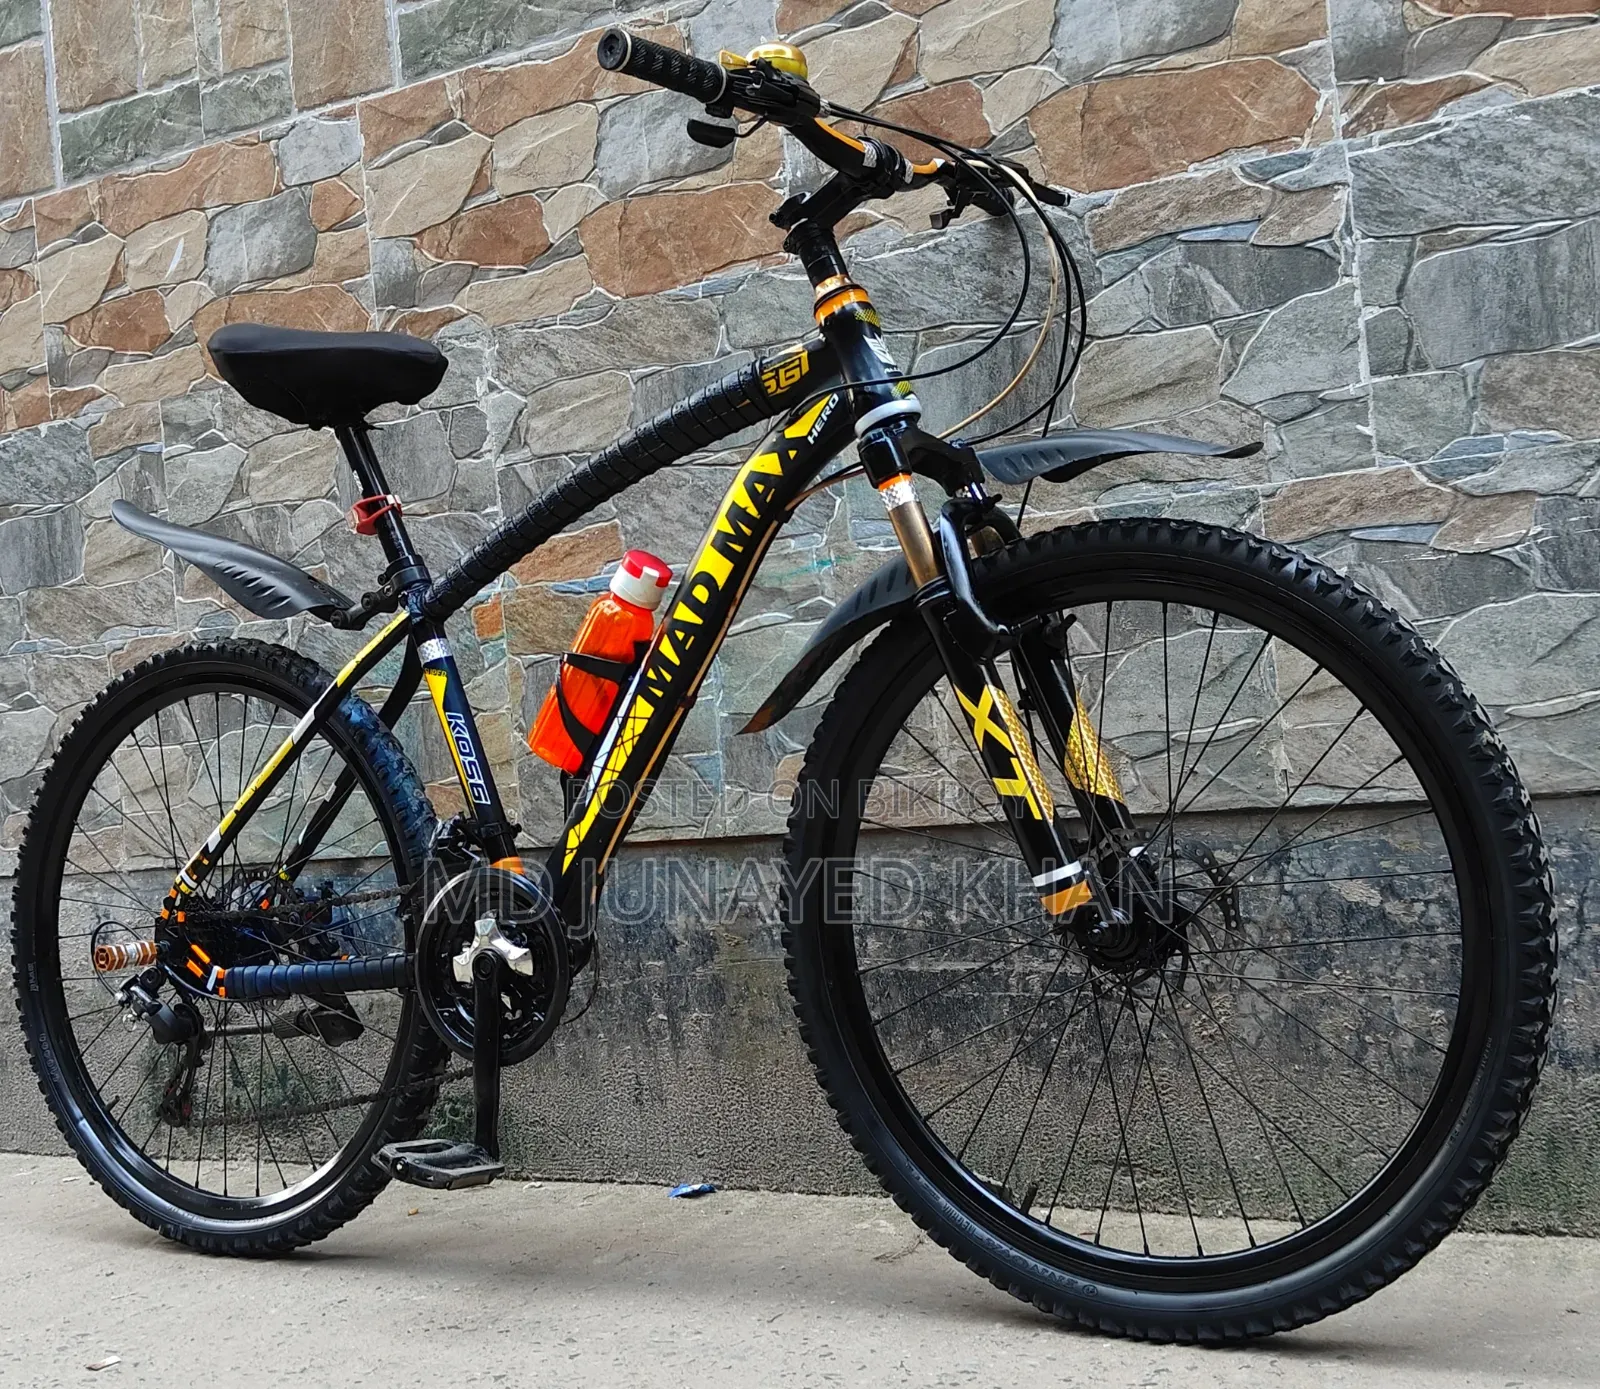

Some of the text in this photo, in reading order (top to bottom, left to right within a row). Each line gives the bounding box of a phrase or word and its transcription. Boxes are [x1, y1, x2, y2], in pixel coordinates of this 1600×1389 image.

[637, 393, 839, 710] MAD MAX HERO
